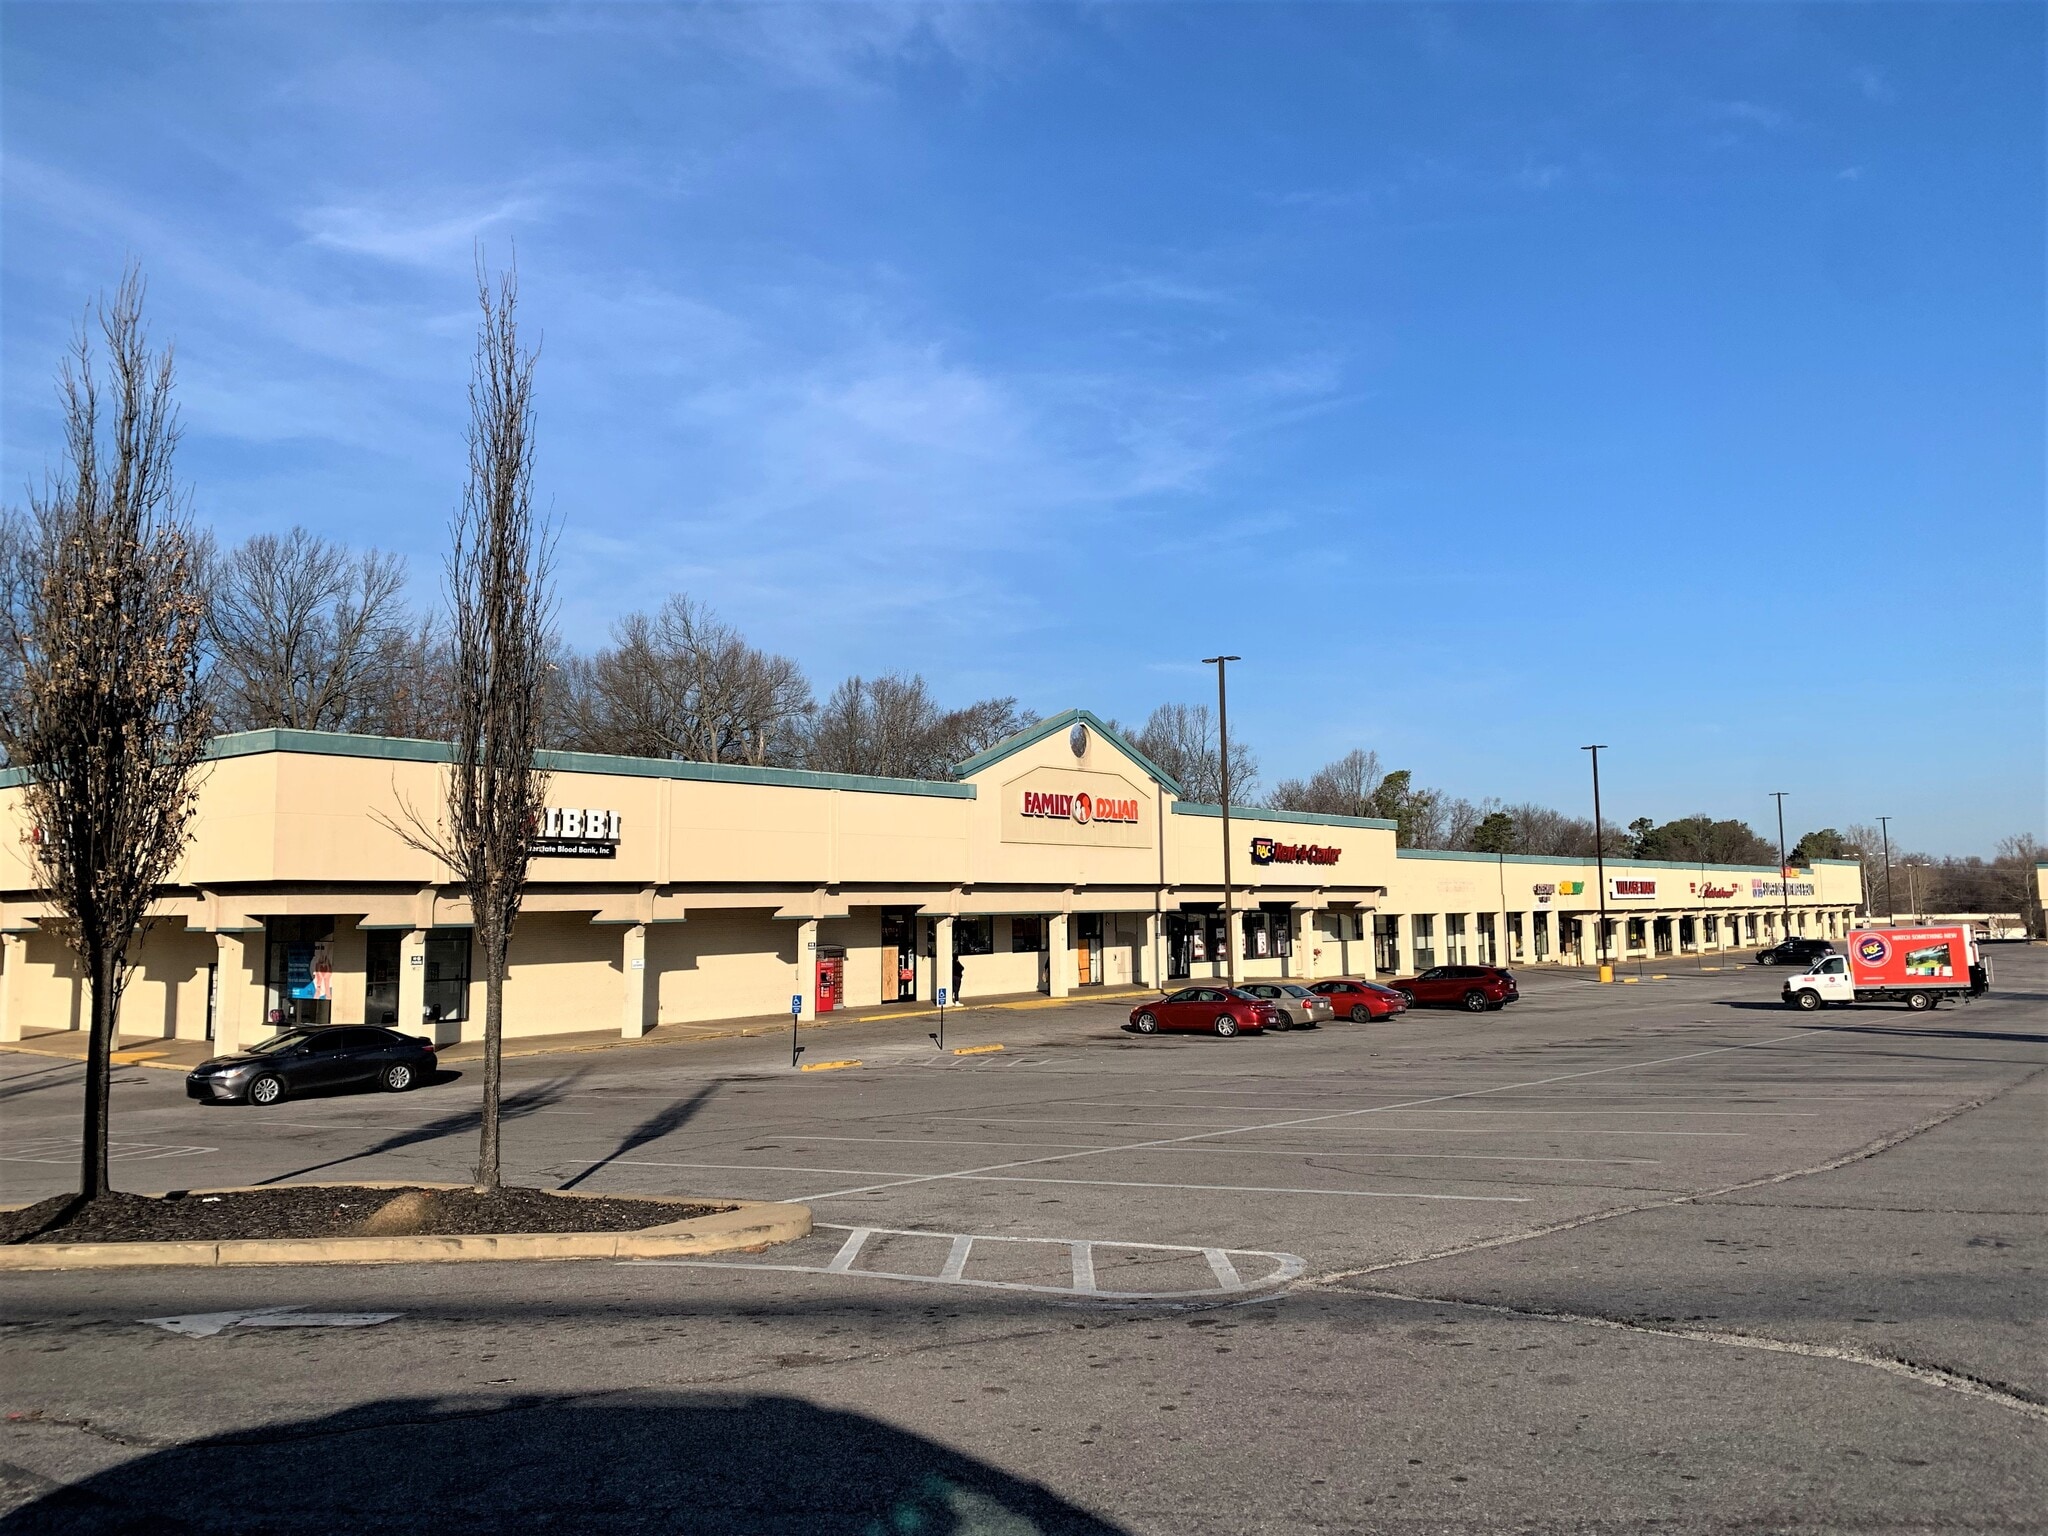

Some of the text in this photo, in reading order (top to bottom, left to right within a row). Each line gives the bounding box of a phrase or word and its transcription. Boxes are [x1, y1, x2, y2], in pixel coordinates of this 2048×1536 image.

[1023, 791, 1138, 820] FAMILY DOLLAR
[544, 807, 620, 839] IBBI
[557, 845, 577, 854] Blood
[578, 846, 598, 855] Bank,
[599, 847, 610, 855] Inc
[1256, 845, 1271, 858] RAC
